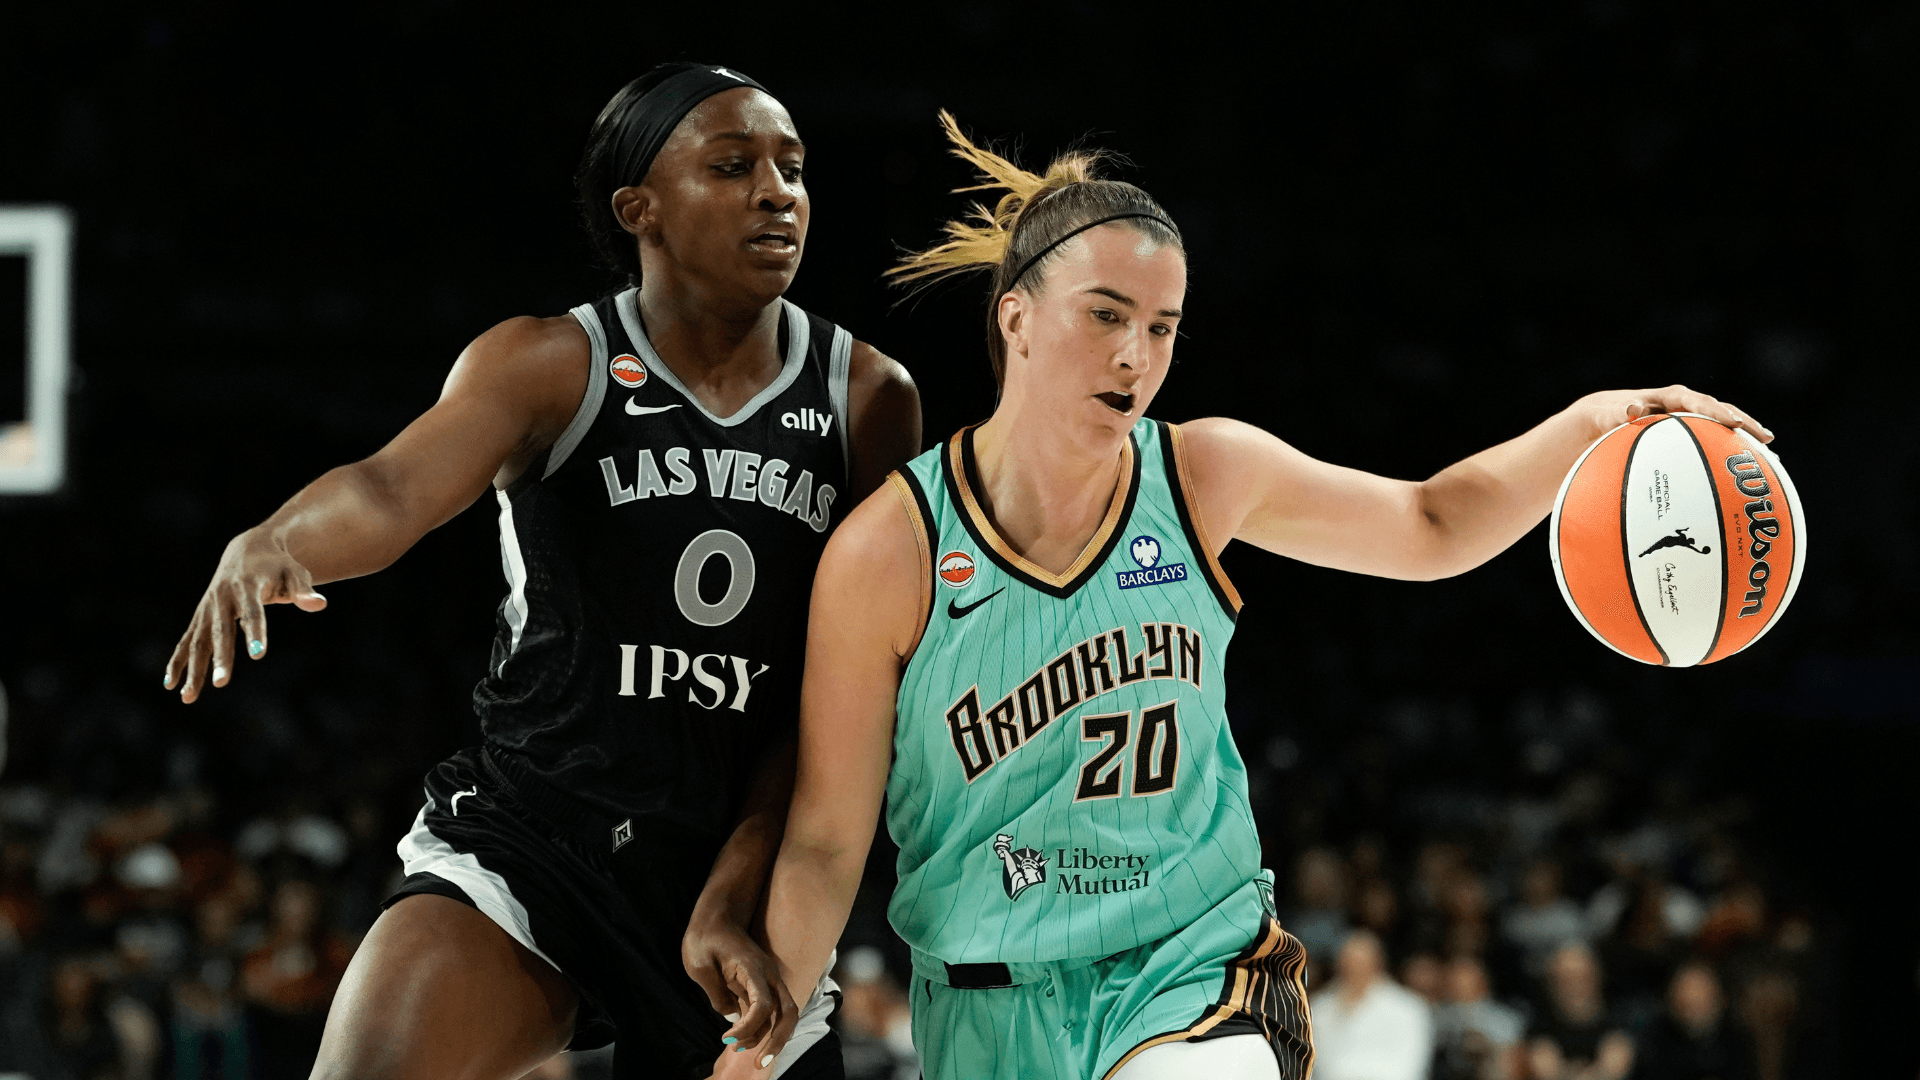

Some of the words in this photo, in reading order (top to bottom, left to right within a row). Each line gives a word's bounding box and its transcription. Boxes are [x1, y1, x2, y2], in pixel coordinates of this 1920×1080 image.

[781, 407, 833, 437] ally
[598, 447, 697, 507] LAS
[702, 448, 837, 533] VEGAS
[1653, 469, 1662, 495] GAME
[1662, 473, 1671, 514] OFFICIAL
[1656, 496, 1664, 521] BALL
[1733, 513, 1742, 534] EVO
[1725, 449, 1781, 619] Wilson
[674, 528, 756, 627] 0
[1118, 564, 1185, 588] BARCLAYS
[617, 644, 770, 713] IPSY
[944, 621, 1202, 786] BROOKLYN
[1073, 698, 1180, 804] 20
[1056, 848, 1150, 872] Liberty
[1055, 873, 1149, 896] Mutual
